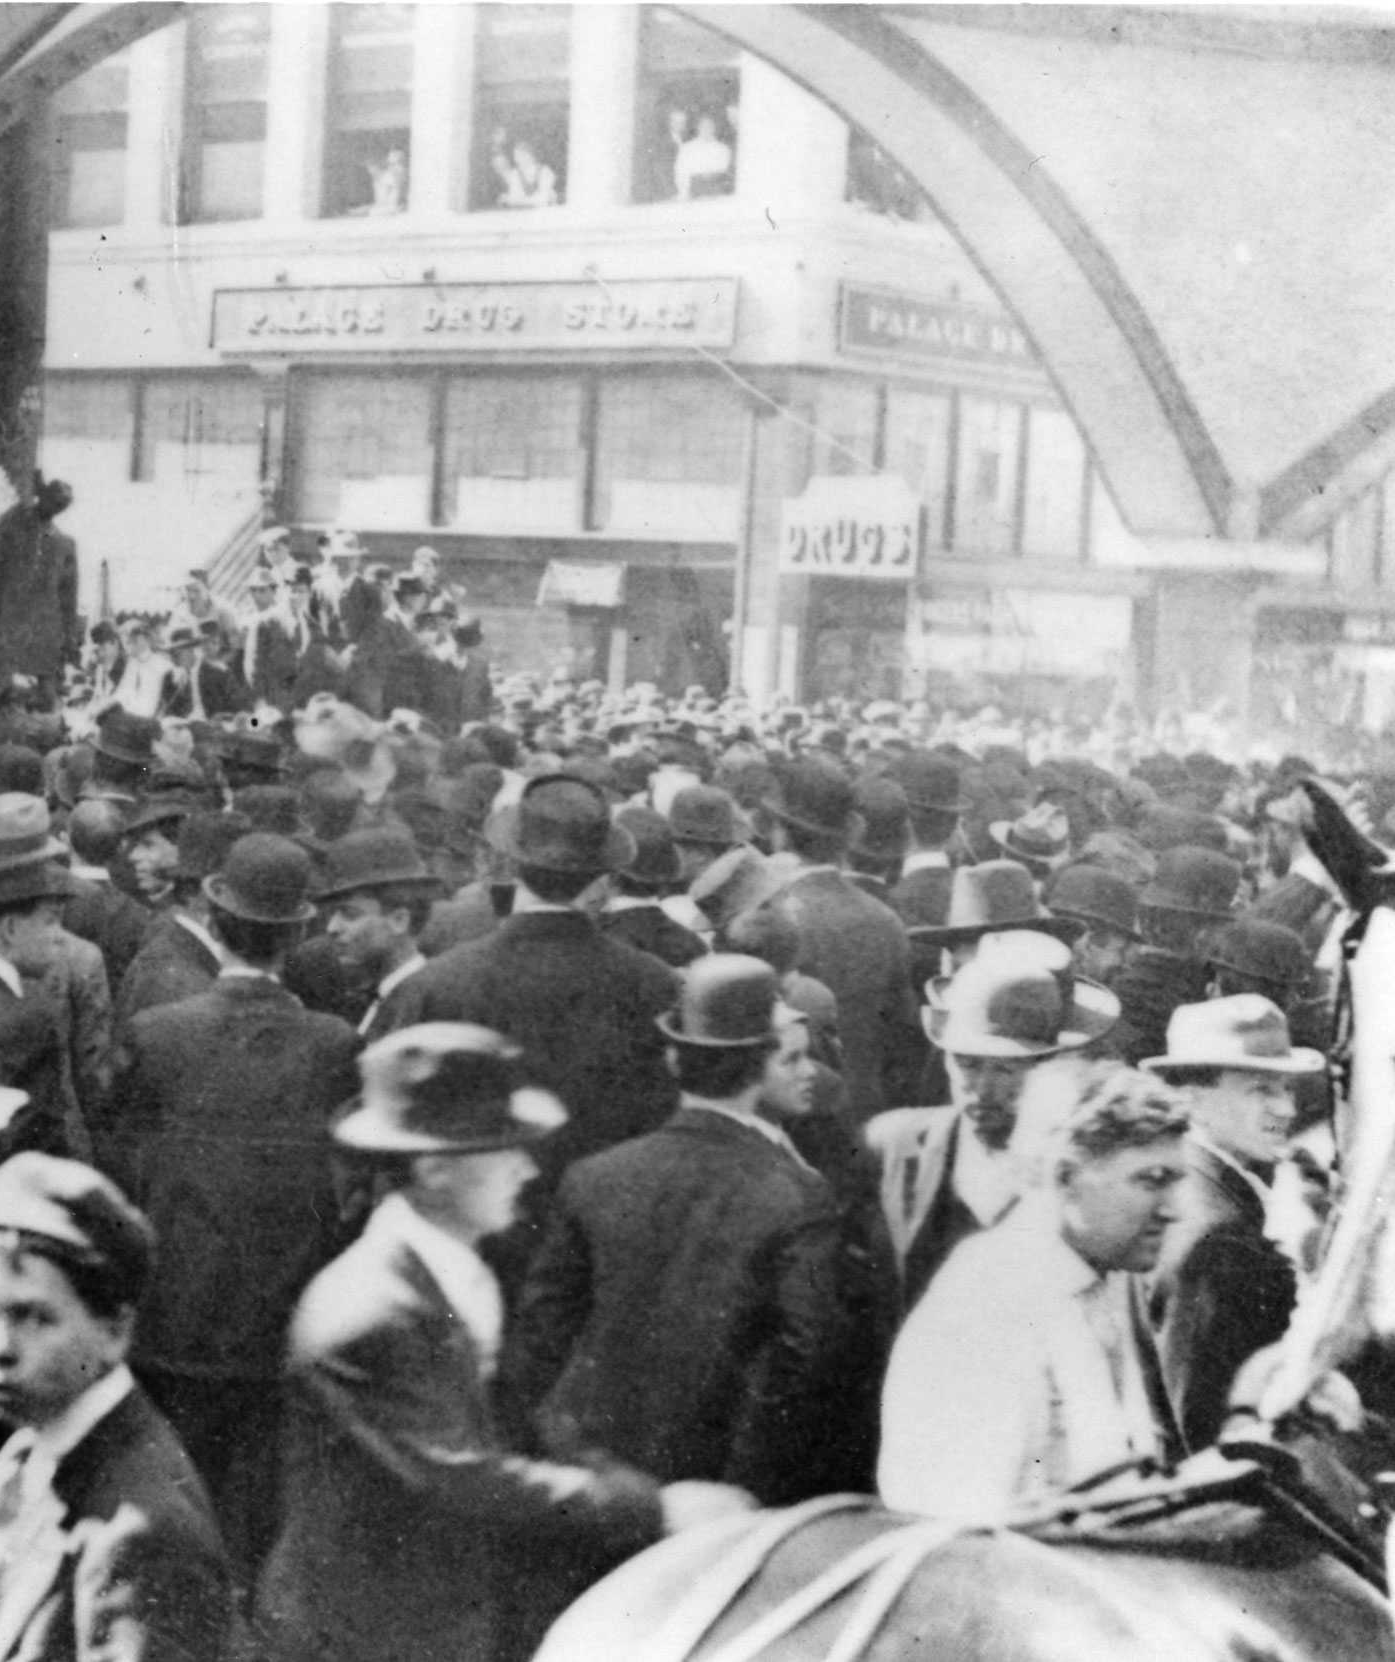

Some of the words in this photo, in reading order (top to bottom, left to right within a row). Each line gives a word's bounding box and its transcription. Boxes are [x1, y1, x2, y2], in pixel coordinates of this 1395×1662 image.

[248, 302, 386, 336] PALACE
[423, 302, 524, 332] DRUG
[564, 299, 696, 331] STORE
[868, 305, 979, 347] PALACE
[786, 518, 913, 566] DRUGS
